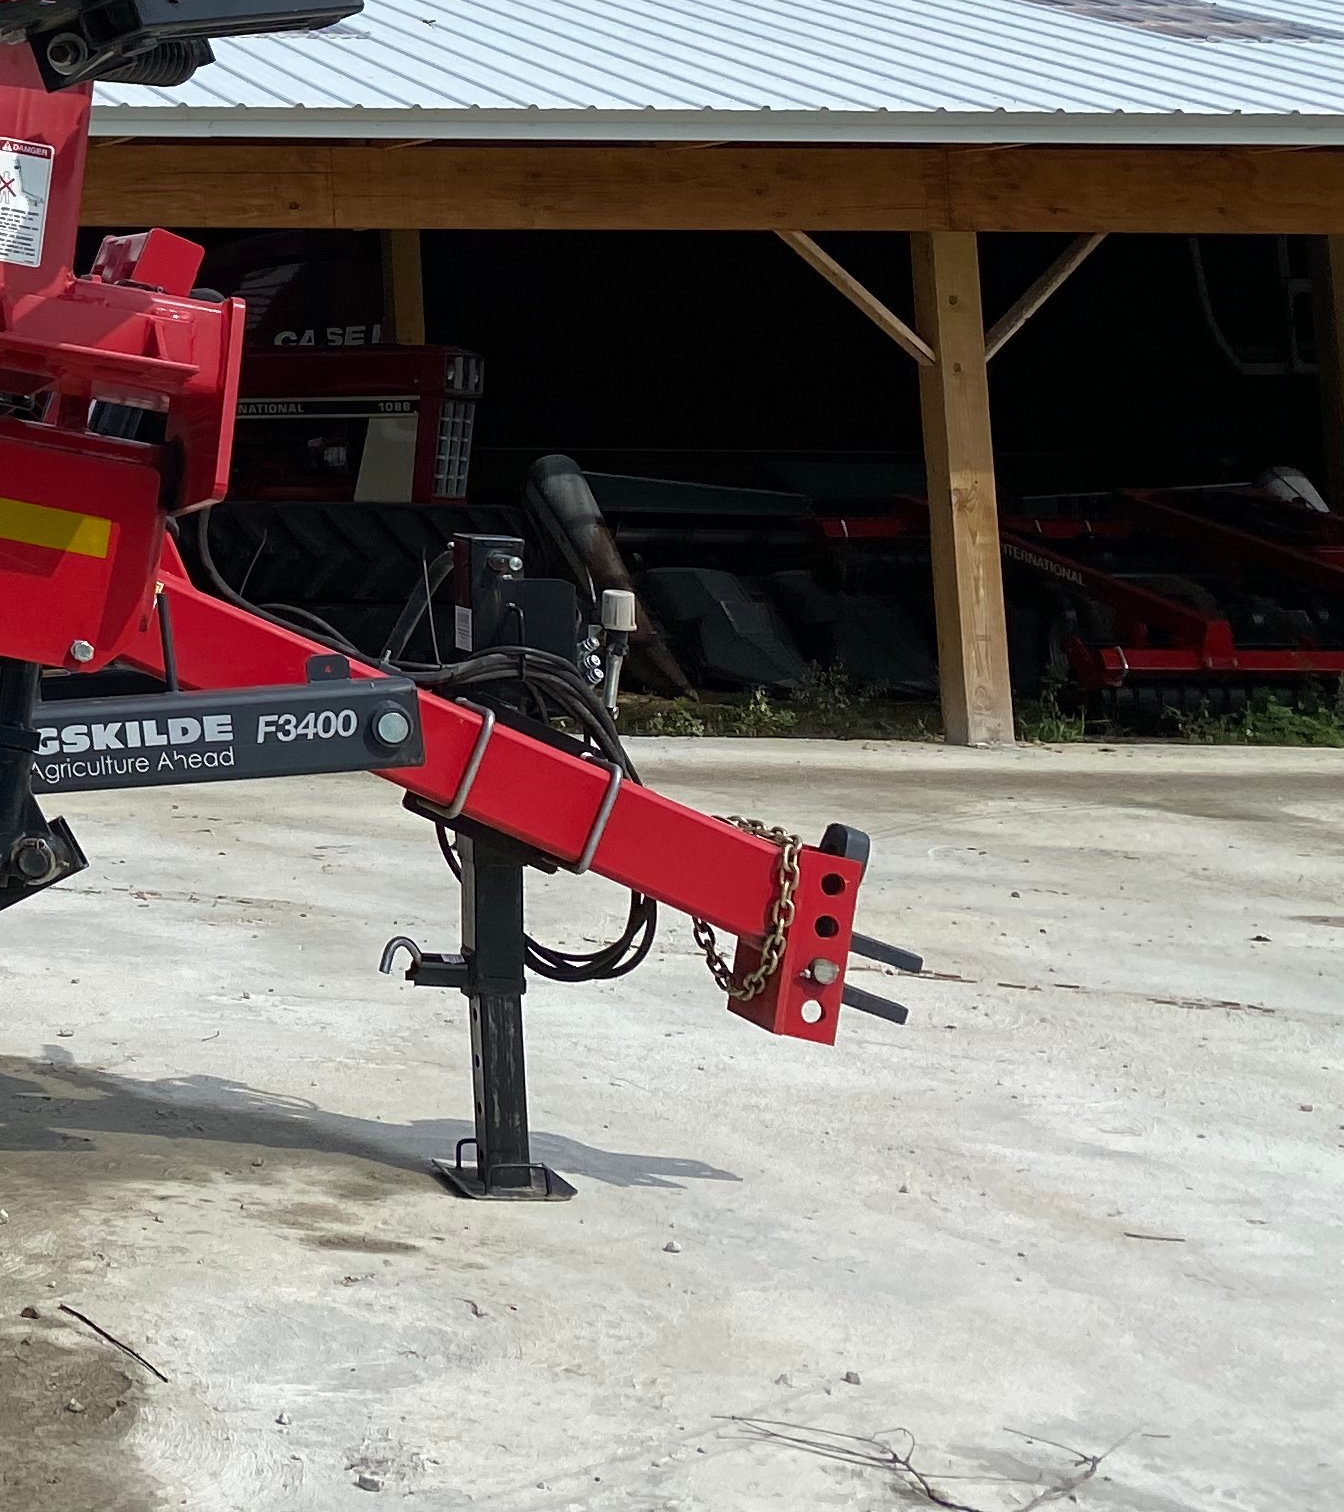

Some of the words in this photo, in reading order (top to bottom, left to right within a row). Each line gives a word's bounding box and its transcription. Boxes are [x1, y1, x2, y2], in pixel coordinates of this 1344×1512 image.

[12, 143, 49, 157] DANGER
[273, 325, 367, 346] CASE
[237, 402, 305, 414] NATIONAL
[256, 708, 358, 744] F3400
[157, 745, 235, 772] Ahead
